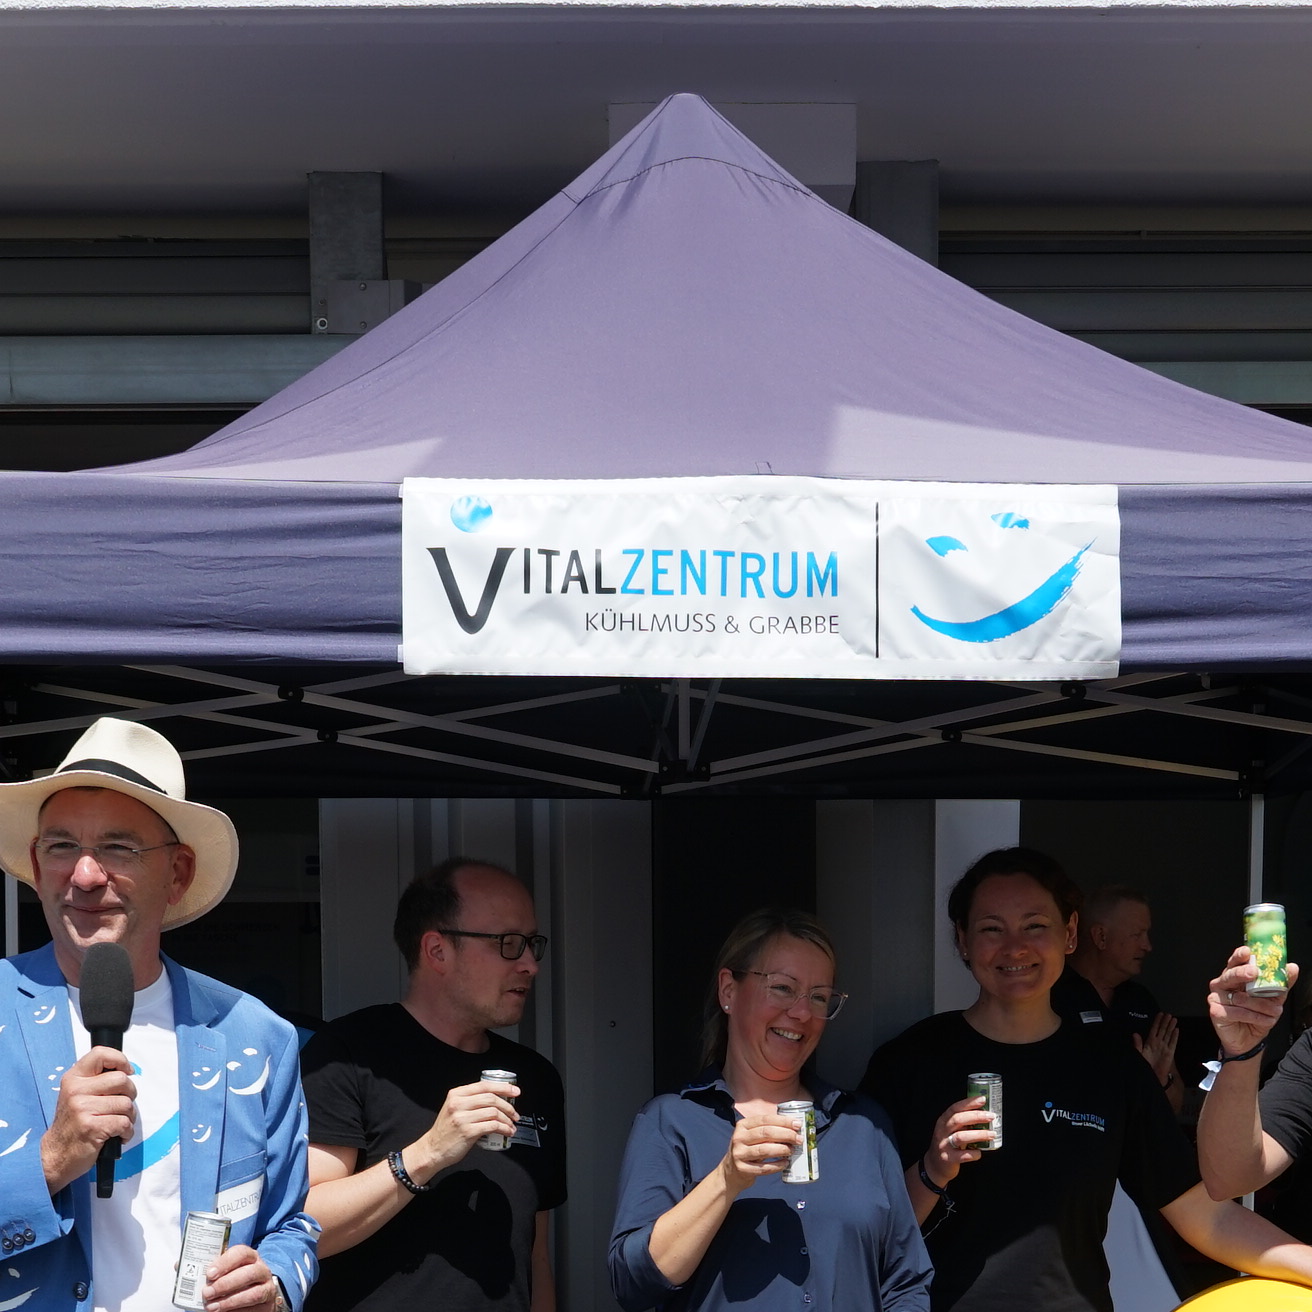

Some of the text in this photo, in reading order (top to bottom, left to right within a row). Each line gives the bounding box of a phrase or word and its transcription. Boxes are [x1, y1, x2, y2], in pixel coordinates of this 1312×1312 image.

[426, 547, 838, 635] VITALZENTRUM
[584, 609, 840, 635] KÜHLMUSS & GRABBE
[1041, 1109, 1105, 1126] VITALZENTRUM
[218, 1190, 260, 1216] ITALZENTR
